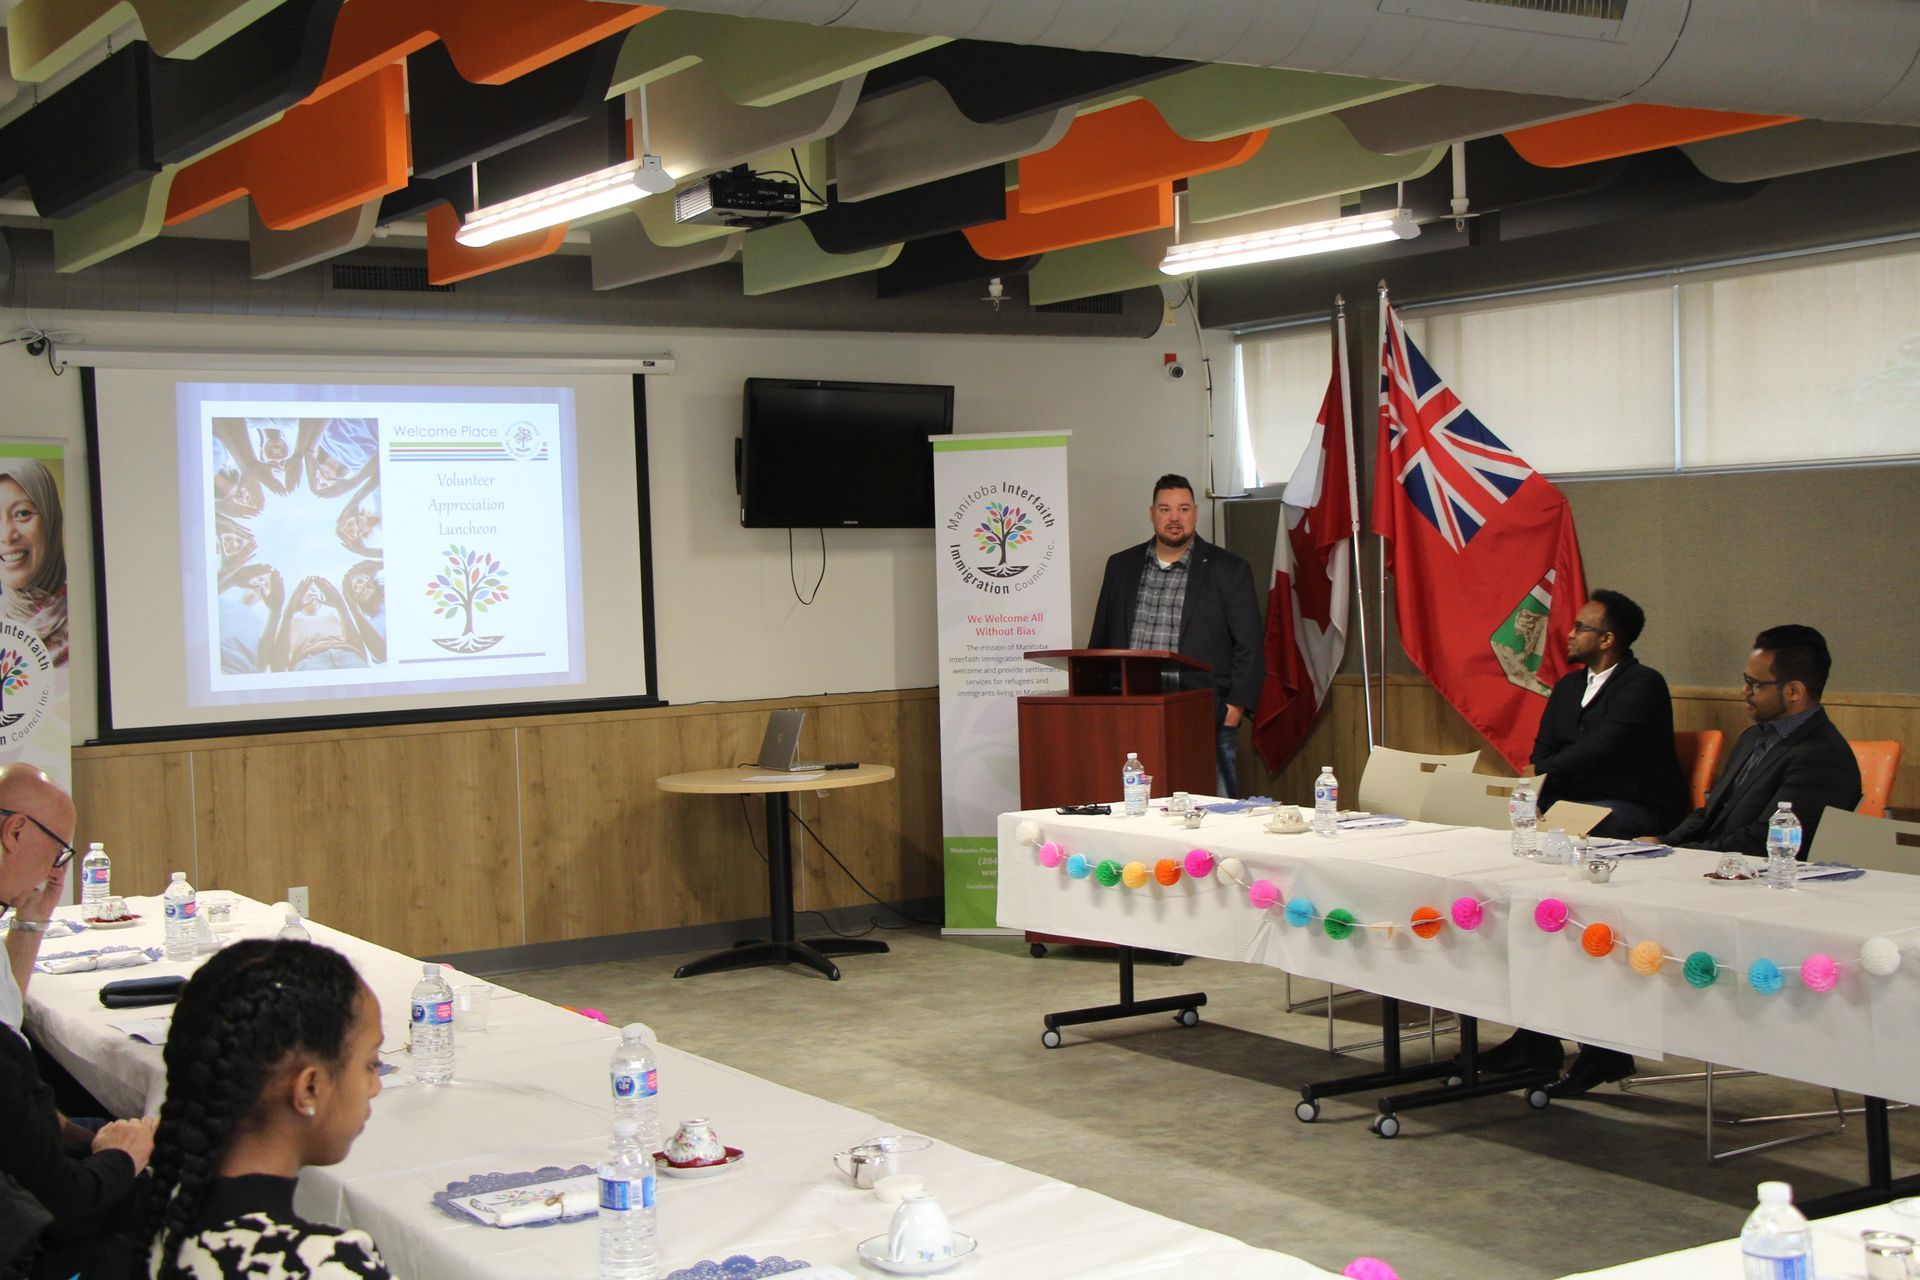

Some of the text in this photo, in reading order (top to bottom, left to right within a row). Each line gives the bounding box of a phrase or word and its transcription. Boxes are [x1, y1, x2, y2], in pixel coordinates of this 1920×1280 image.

[393, 425, 498, 438] Welcome Place
[436, 471, 496, 487] Volunteer
[427, 498, 505, 515] Appreciation
[947, 481, 1055, 531] Manitoba Interfaith
[438, 520, 498, 536] Luncheon
[950, 541, 1056, 595] Immigration Council Inc.
[967, 613, 1043, 623] We Welcome All
[975, 626, 1036, 636] Without Bias
[1007, 643, 1015, 651] of
[981, 655, 1022, 664] Immigration
[952, 667, 982, 675] welcome
[997, 666, 1024, 675] provide
[966, 678, 992, 686] services
[1004, 677, 1034, 687] refugees
[1035, 677, 1049, 685] and
[957, 690, 995, 699] immigrants
[996, 689, 1014, 698] living
[11, 710, 42, 742] Council
